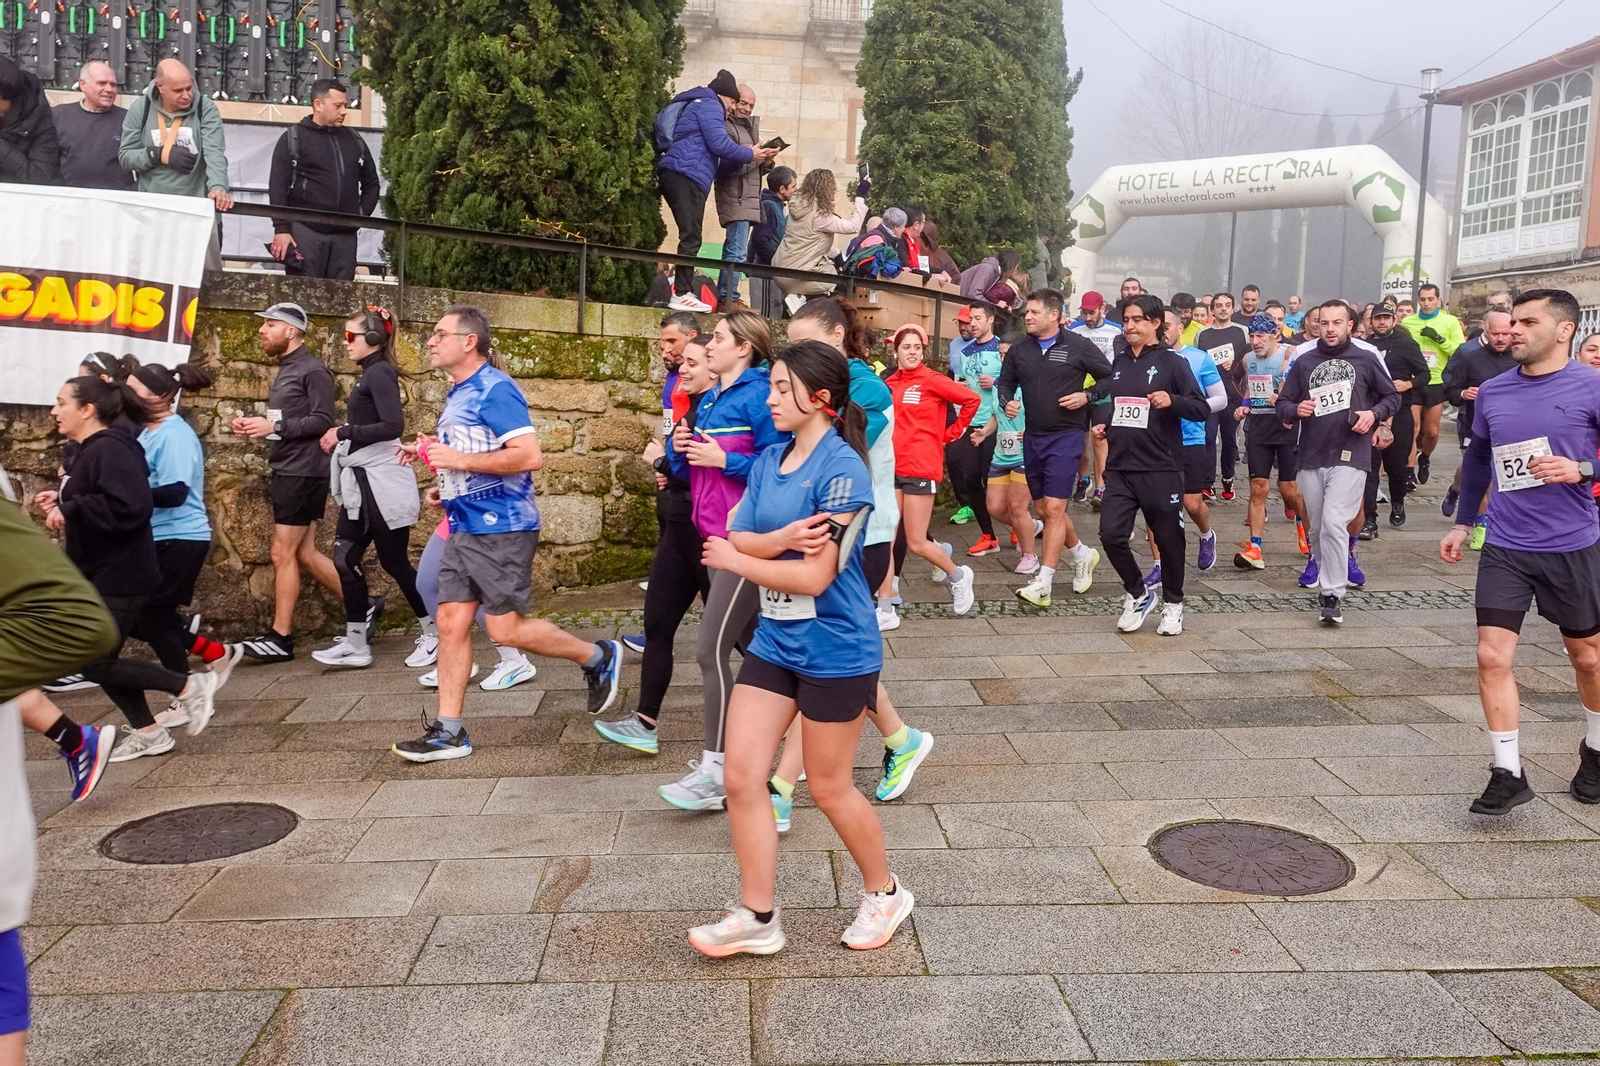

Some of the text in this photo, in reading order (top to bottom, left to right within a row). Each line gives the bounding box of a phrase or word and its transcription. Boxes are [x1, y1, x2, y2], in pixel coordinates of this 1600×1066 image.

[1118, 172, 1179, 191] HOTEL
[1192, 169, 1216, 187] LA
[1118, 189, 1236, 206] www.hotelrectoral.com
[0, 272, 166, 332] GADIS
[1213, 350, 1229, 360] 532
[1252, 382, 1266, 392] 161
[1320, 390, 1344, 408] 512
[1119, 406, 1140, 419] 130
